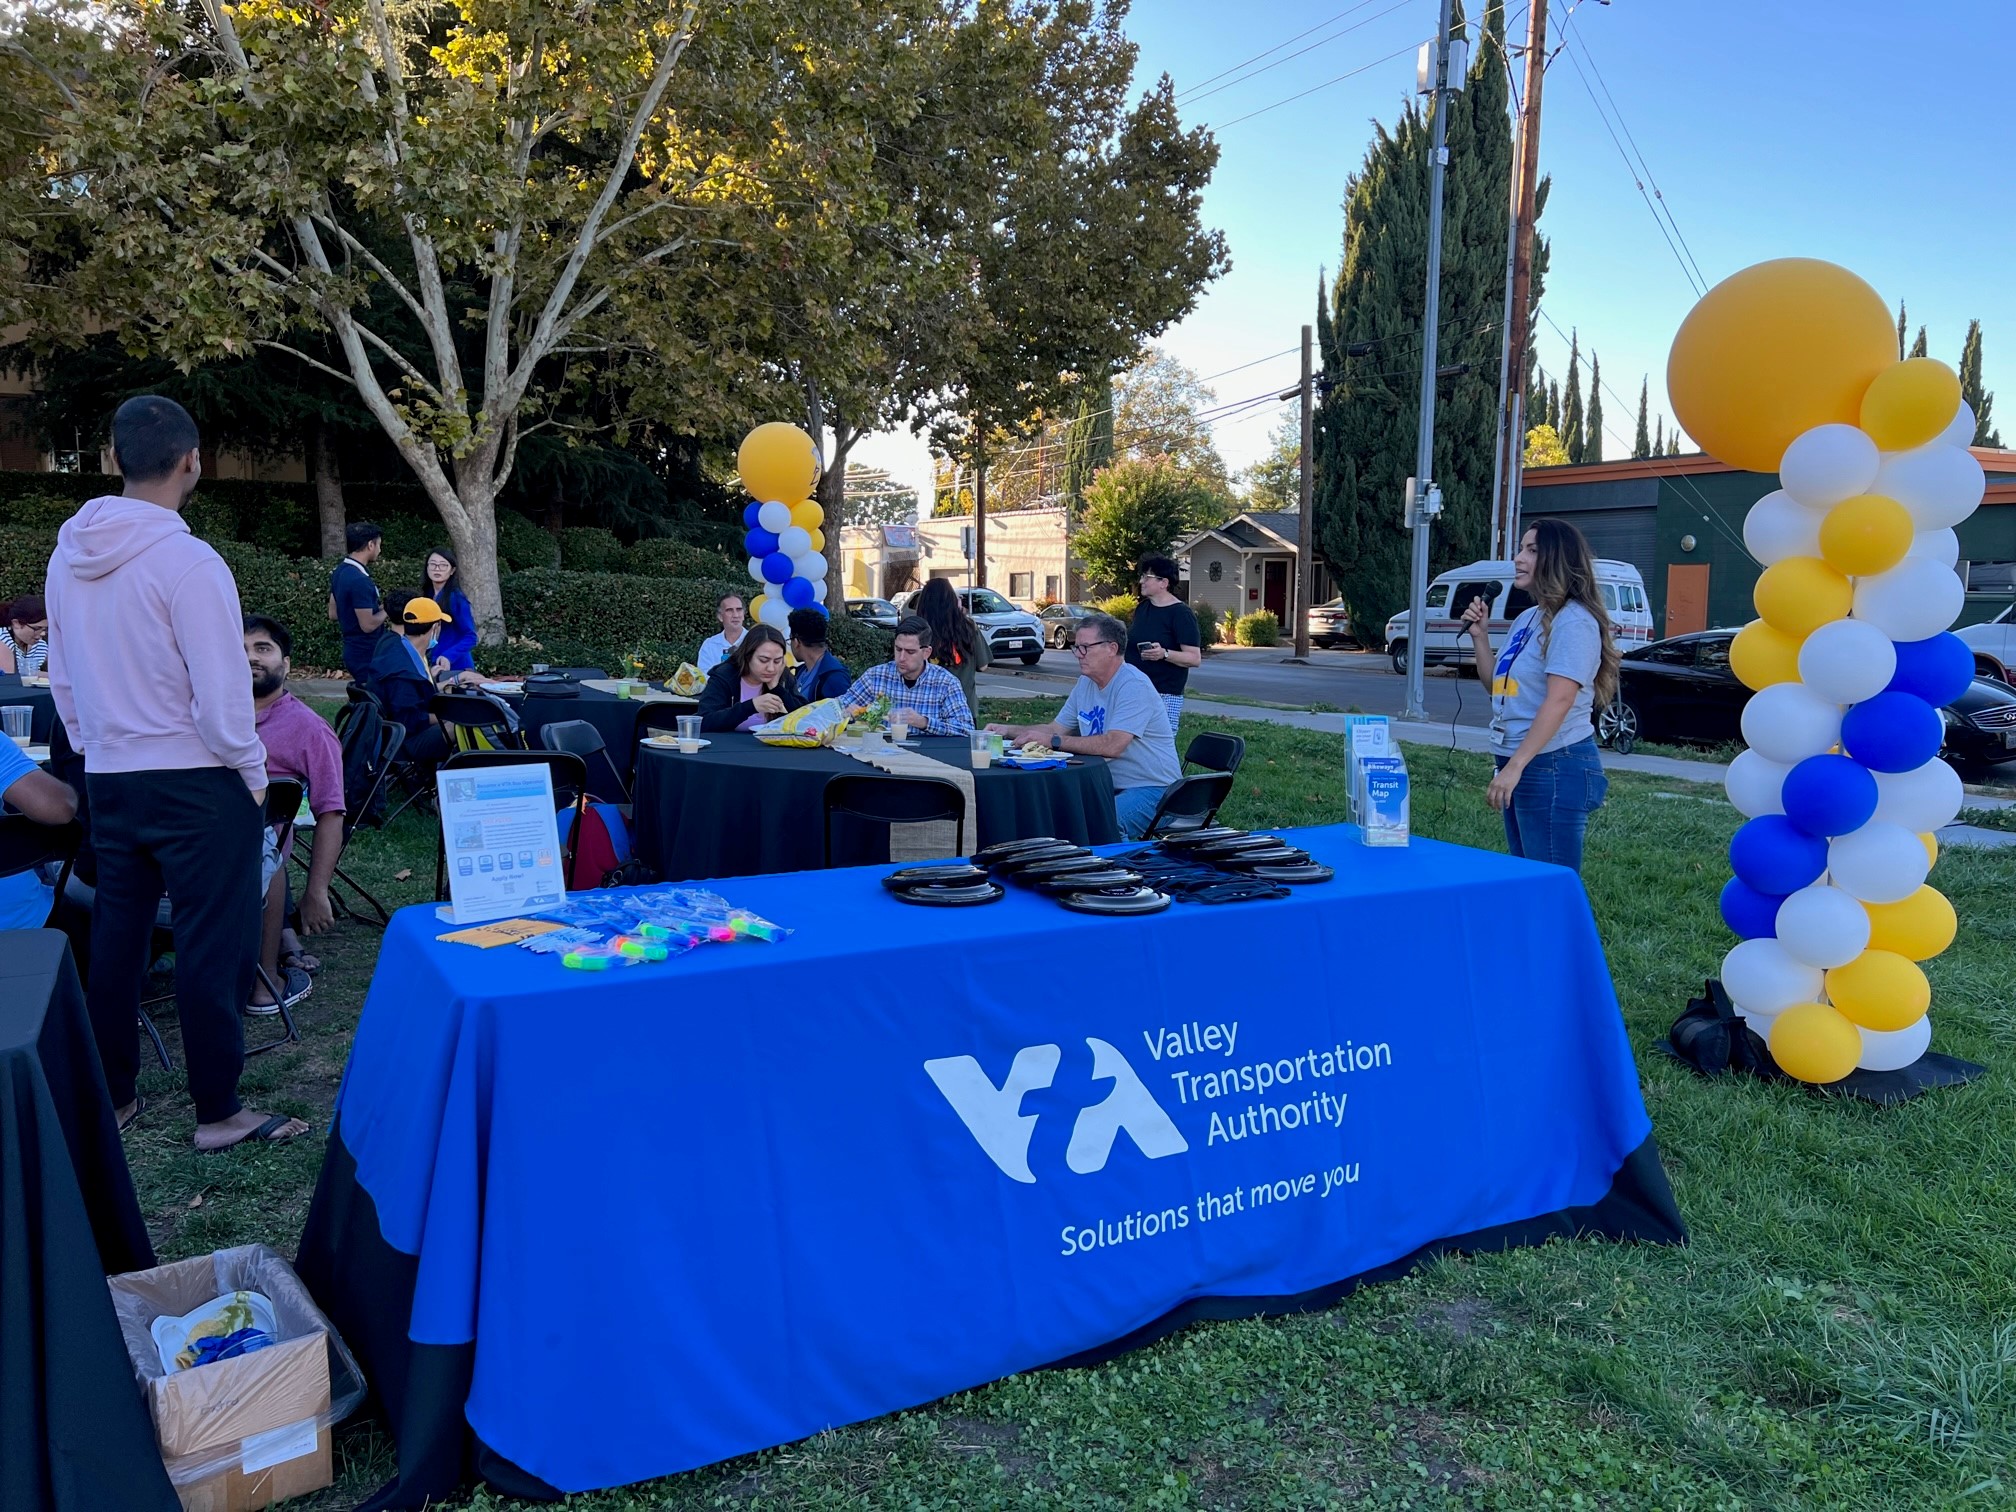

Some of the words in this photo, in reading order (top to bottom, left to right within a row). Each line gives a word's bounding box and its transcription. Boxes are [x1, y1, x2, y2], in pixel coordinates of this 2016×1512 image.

[1372, 781, 1399, 789] Transit
[1372, 789, 1390, 798] Map
[1143, 1021, 1238, 1061] Valley
[1171, 1040, 1392, 1104] Transportation
[1207, 1090, 1348, 1147] Authority
[1061, 1205, 1190, 1256] Solutions
[1197, 1186, 1245, 1222] that
[1250, 1173, 1316, 1208] move
[1320, 1162, 1360, 1198] you
